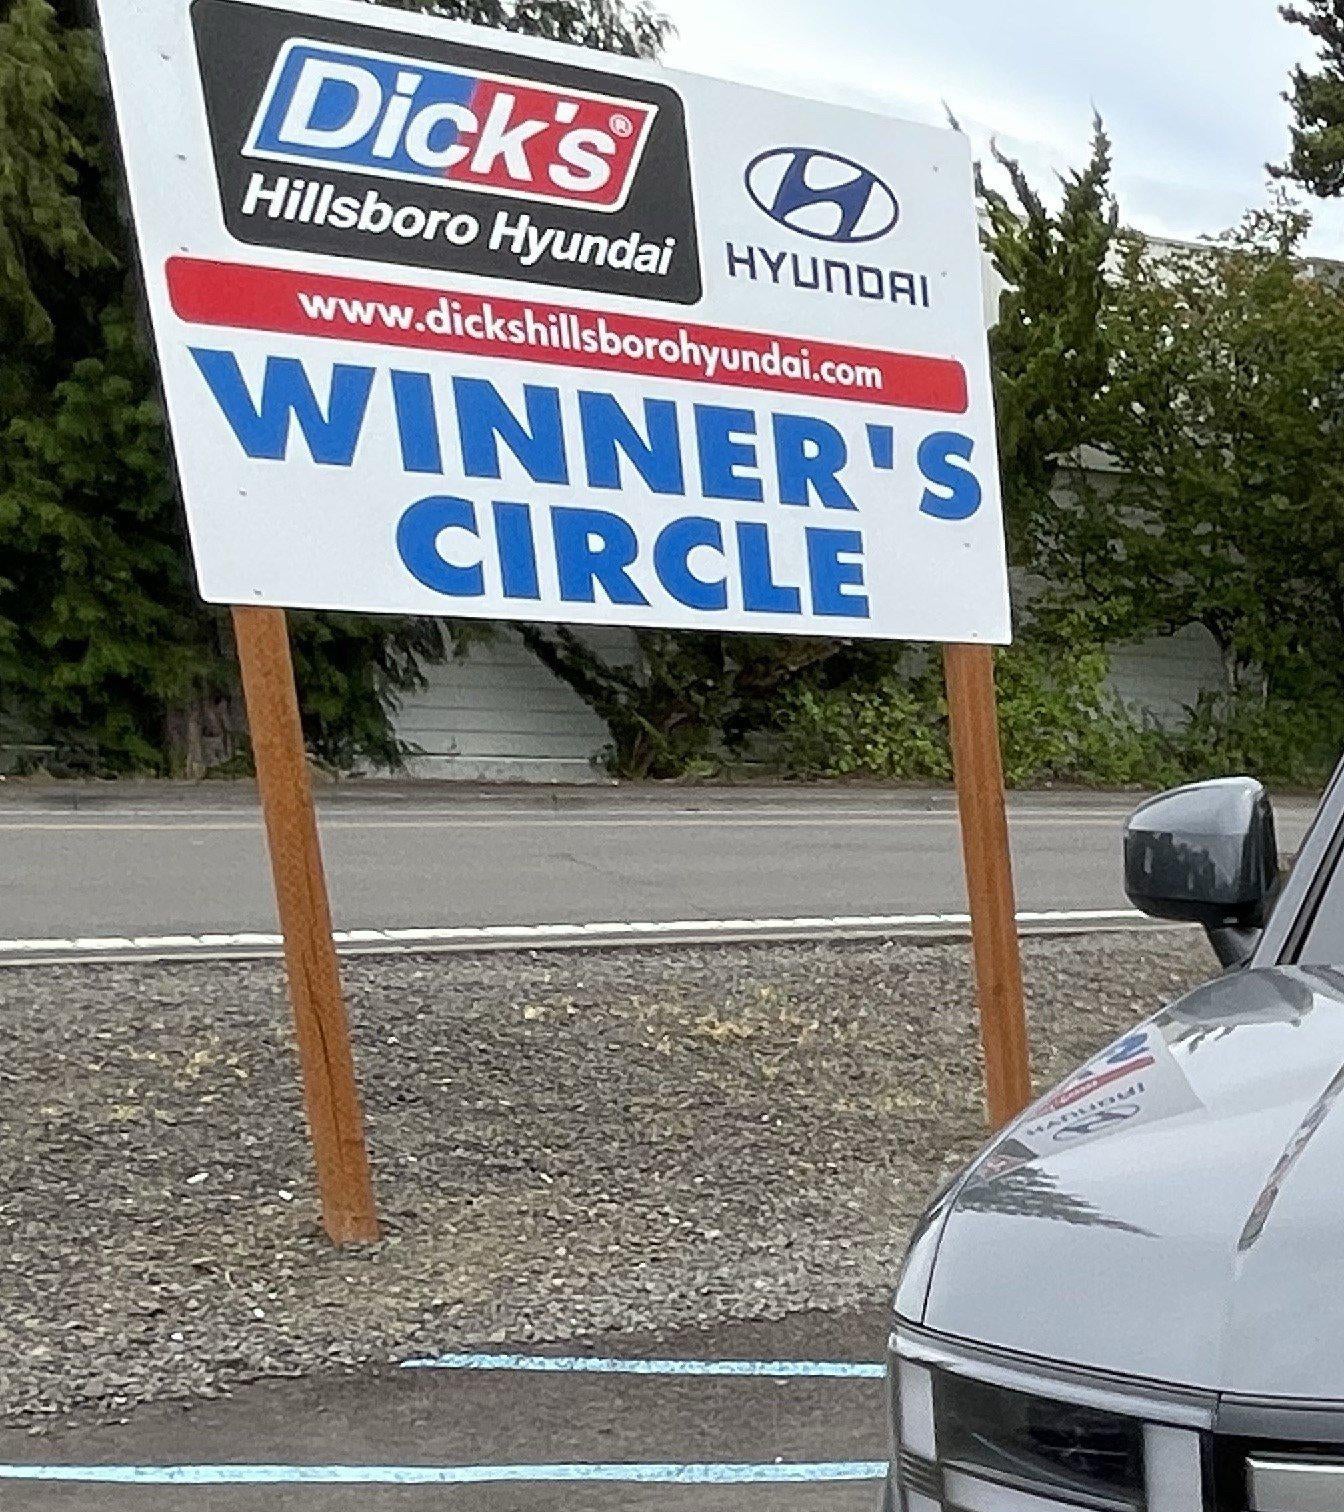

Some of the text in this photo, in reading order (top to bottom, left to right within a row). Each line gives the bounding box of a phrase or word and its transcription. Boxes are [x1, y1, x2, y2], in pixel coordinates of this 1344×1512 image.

[241, 172, 677, 276] Hillsboro Hyundai
[726, 242, 930, 308] HYUNDAI
[297, 291, 884, 391] www.dickshillsborohyundai.com
[187, 345, 984, 522] WINNER'S
[394, 494, 872, 619] CIRCLE
